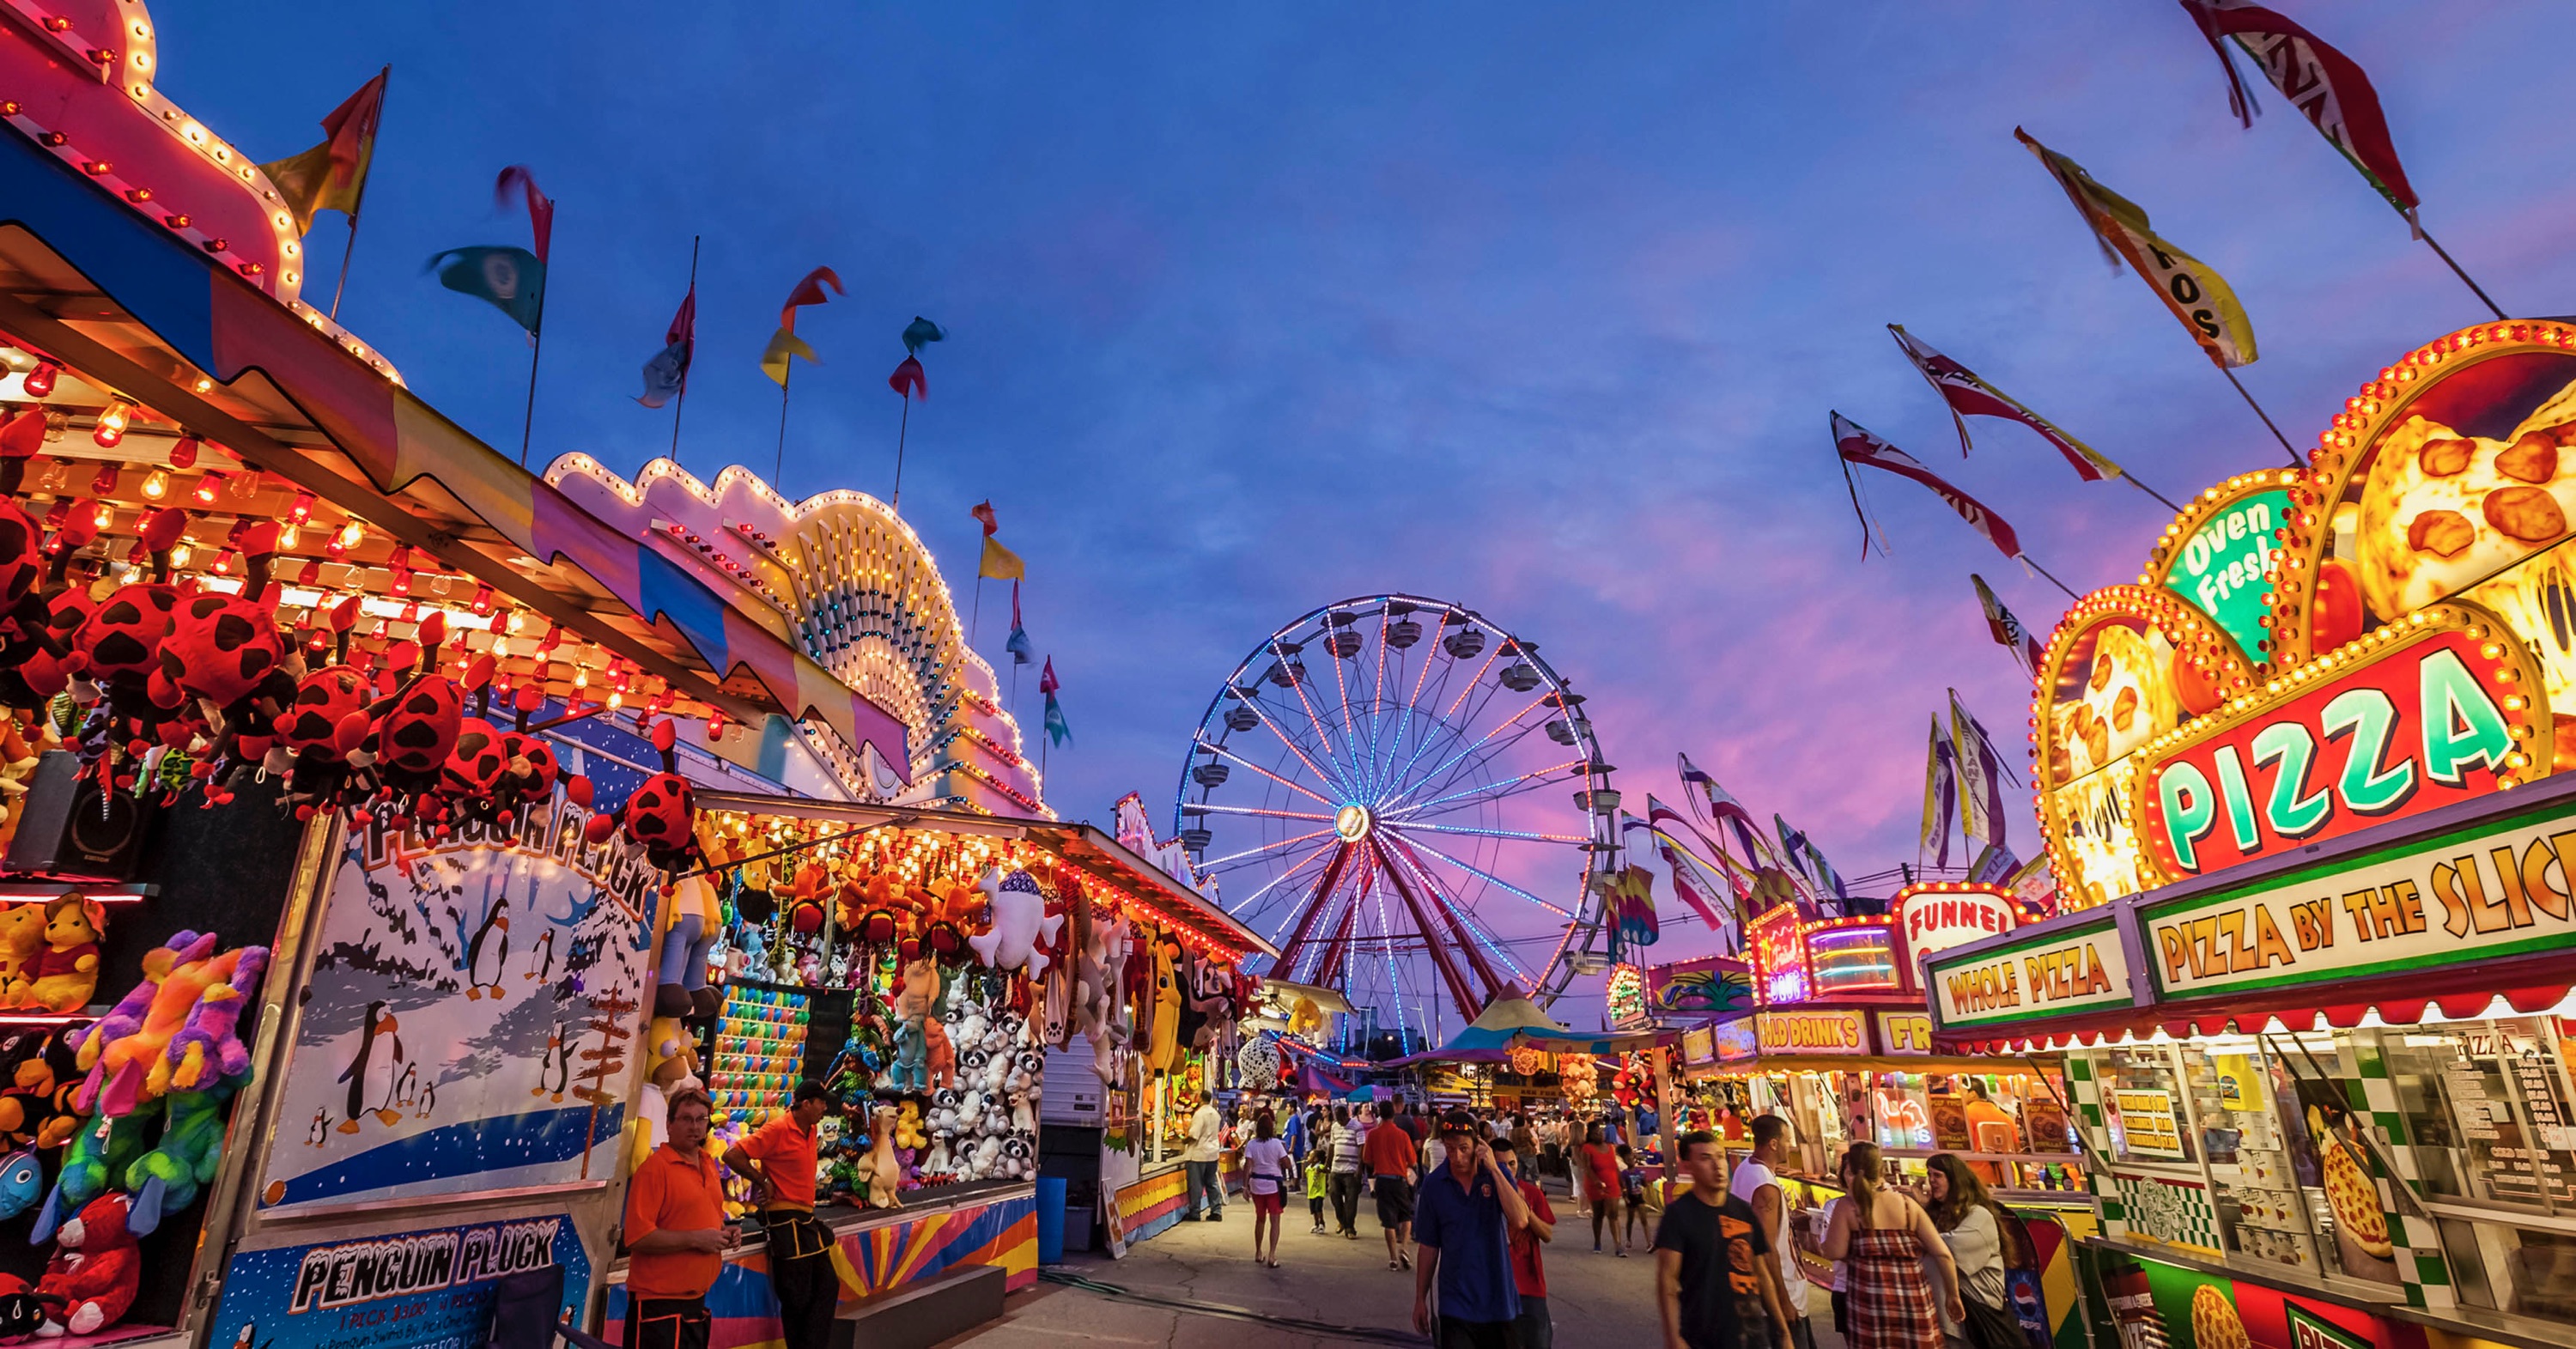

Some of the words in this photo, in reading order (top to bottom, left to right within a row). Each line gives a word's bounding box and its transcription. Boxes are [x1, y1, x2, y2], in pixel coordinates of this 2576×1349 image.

[2184, 503, 2270, 576] Oven
[2196, 536, 2279, 616] Fresh
[2157, 647, 2516, 870] PIZZA
[2158, 903, 2295, 983] PIZZA
[2290, 897, 2333, 952] BY
[2342, 878, 2427, 942] THE
[1947, 961, 2020, 1015] WHOLE
[2024, 943, 2112, 1003] PIZZA
[1790, 1017, 1860, 1048] DRINKS
[2457, 1034, 2518, 1055] PIZZA
[295, 1235, 455, 1310] PENGUIN
[457, 1222, 558, 1284] PLUCK
[349, 1310, 386, 1329] PICK
[391, 1302, 428, 1322] $3.00
[449, 1291, 488, 1309] PICKS
